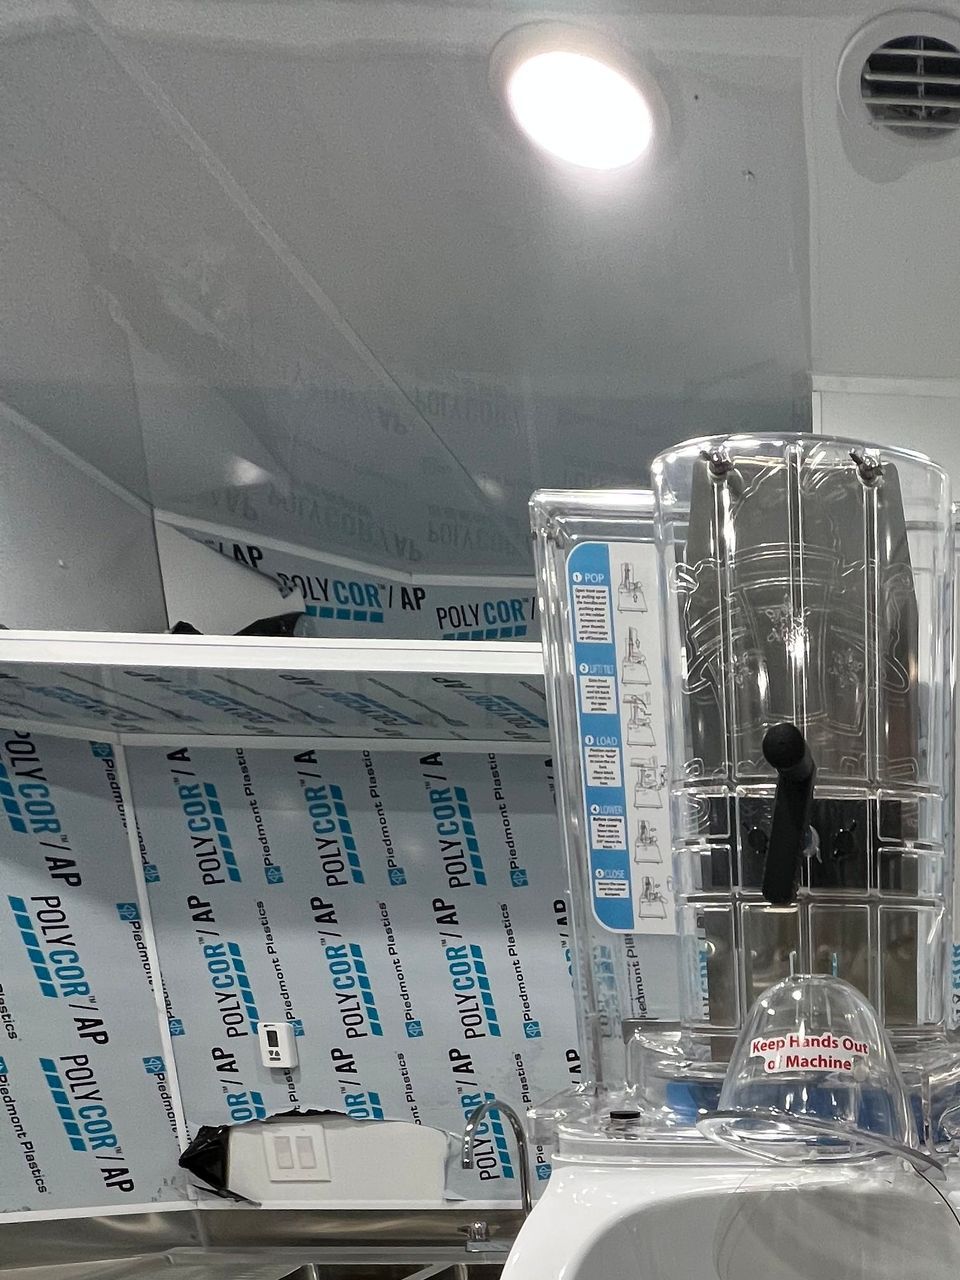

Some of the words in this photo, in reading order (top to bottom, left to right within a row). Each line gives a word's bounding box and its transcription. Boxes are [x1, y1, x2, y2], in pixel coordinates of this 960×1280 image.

[584, 573, 604, 583] POP
[400, 586, 426, 611] AP
[596, 736, 618, 746] LOAD
[236, 748, 255, 797] Plastic
[362, 750, 380, 799] Plastic
[488, 752, 505, 800] Plastic
[249, 800, 274, 866] Piedmont
[374, 801, 397, 868] Piedmont
[499, 803, 520, 869] Piedmont
[44, 856, 82, 887] AP
[604, 869, 625, 879] CLOSE
[187, 895, 215, 923] AP
[257, 900, 277, 955] Plastics
[310, 896, 338, 924] AP
[432, 897, 459, 925] AP
[379, 902, 398, 956] Plastics
[500, 903, 518, 957] Plastics
[272, 957, 296, 1020] Piedmont
[393, 958, 415, 1021] Piedmont
[512, 959, 533, 1021] Piedmont
[73, 1016, 110, 1046] AP
[752, 1038, 785, 1053] Keep
[789, 1035, 838, 1049] Hands
[843, 1038, 868, 1054] Out
[211, 1047, 240, 1073] AP
[331, 1047, 358, 1073] AP
[398, 1053, 416, 1102] Plastics
[449, 1048, 477, 1074] AP
[515, 1053, 532, 1103] Plastics
[786, 1055, 851, 1070] Machine
[0, 1074, 27, 1139] Piedmont
[20, 1141, 48, 1194] Plastics
[100, 1166, 135, 1193] AP
